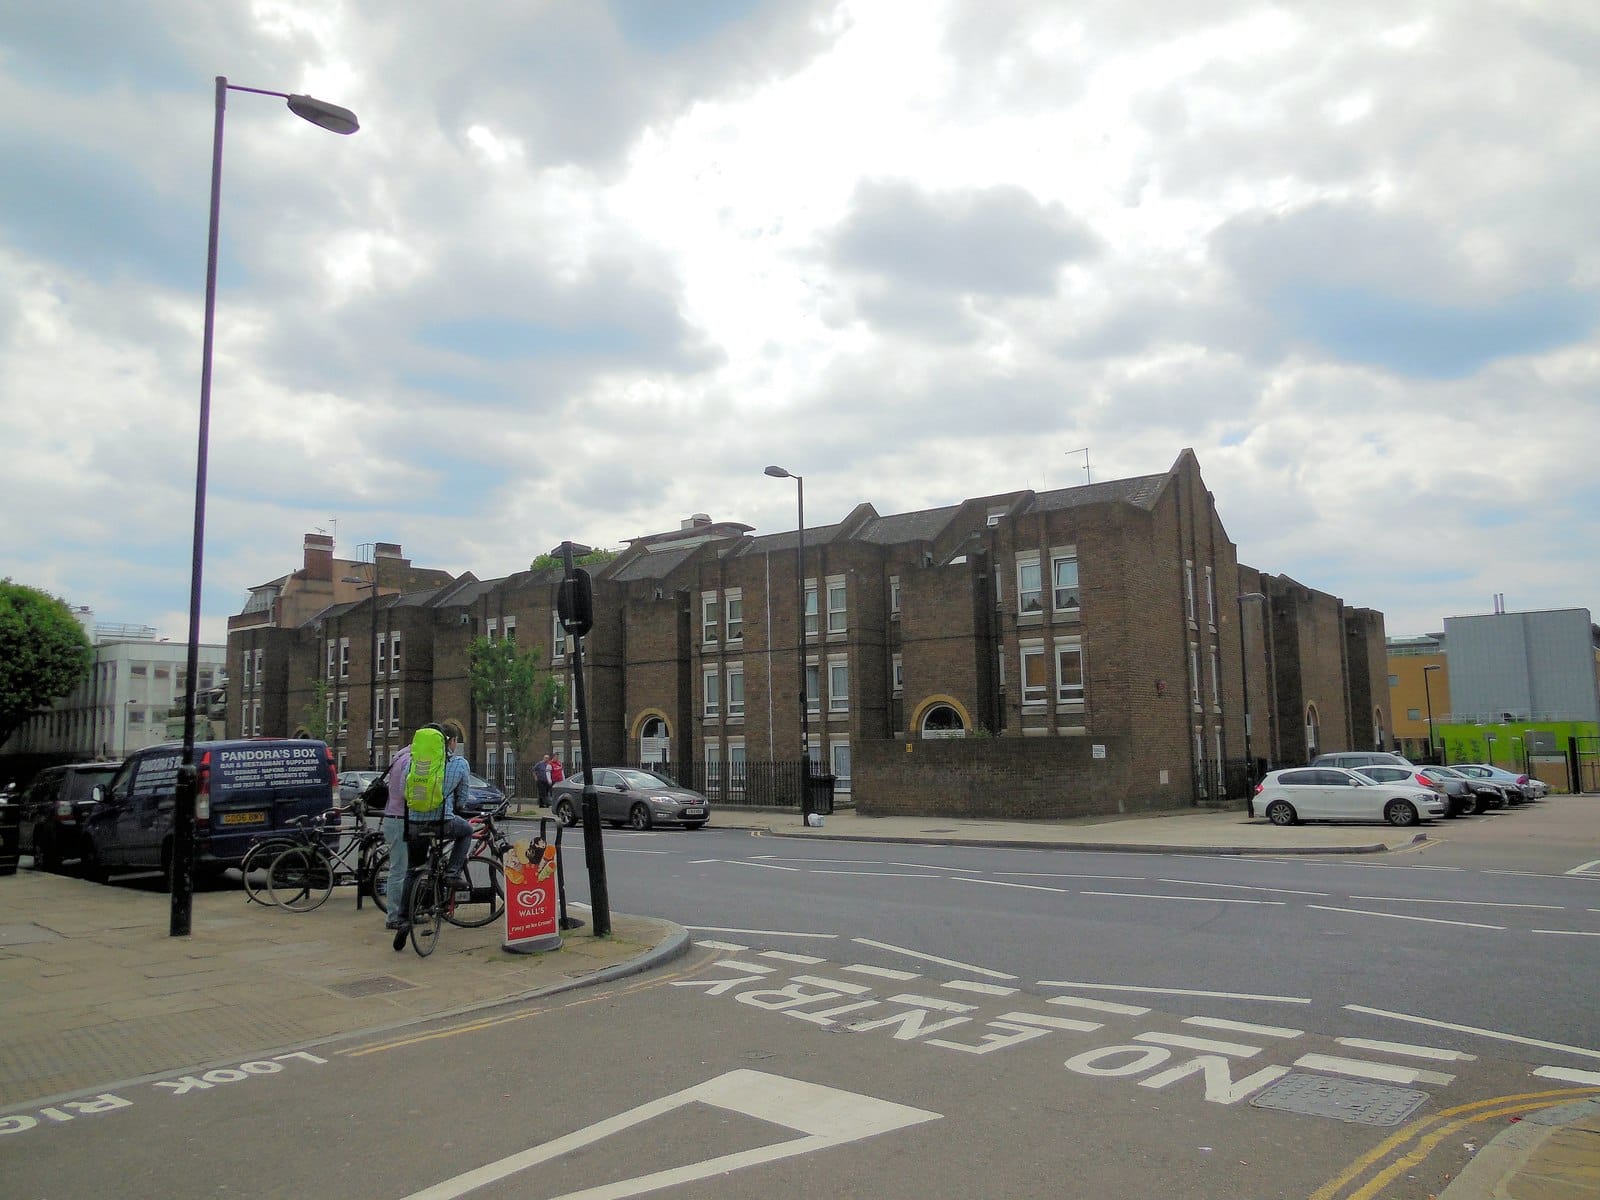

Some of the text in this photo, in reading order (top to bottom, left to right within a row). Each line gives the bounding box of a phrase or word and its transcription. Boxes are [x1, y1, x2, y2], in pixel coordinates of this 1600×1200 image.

[221, 748, 317, 761] PANDORA'S BOX
[519, 907, 545, 917] WALL'S
[671, 975, 1292, 1105] NO ENTRY
[152, 1051, 329, 1095] LOOK
